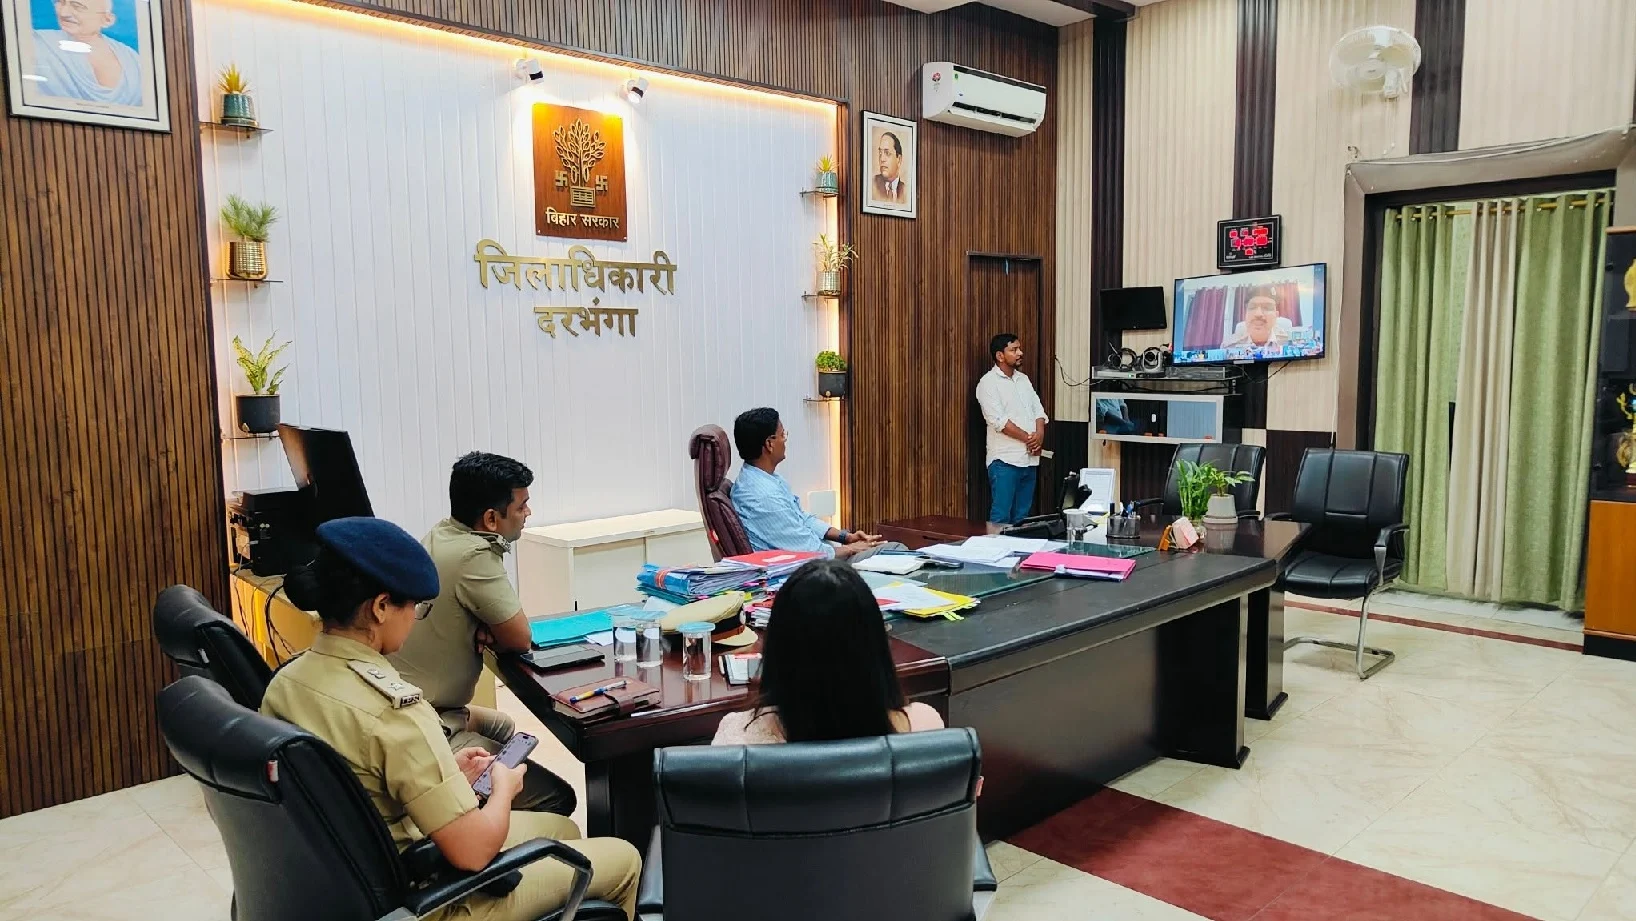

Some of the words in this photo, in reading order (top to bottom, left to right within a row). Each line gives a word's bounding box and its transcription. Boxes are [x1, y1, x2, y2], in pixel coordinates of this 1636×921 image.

[545, 207, 577, 226] बिहार
[580, 214, 619, 228] सरकार
[474, 239, 677, 295] जिलाधिकारी
[534, 297, 639, 339] दरभंगा
